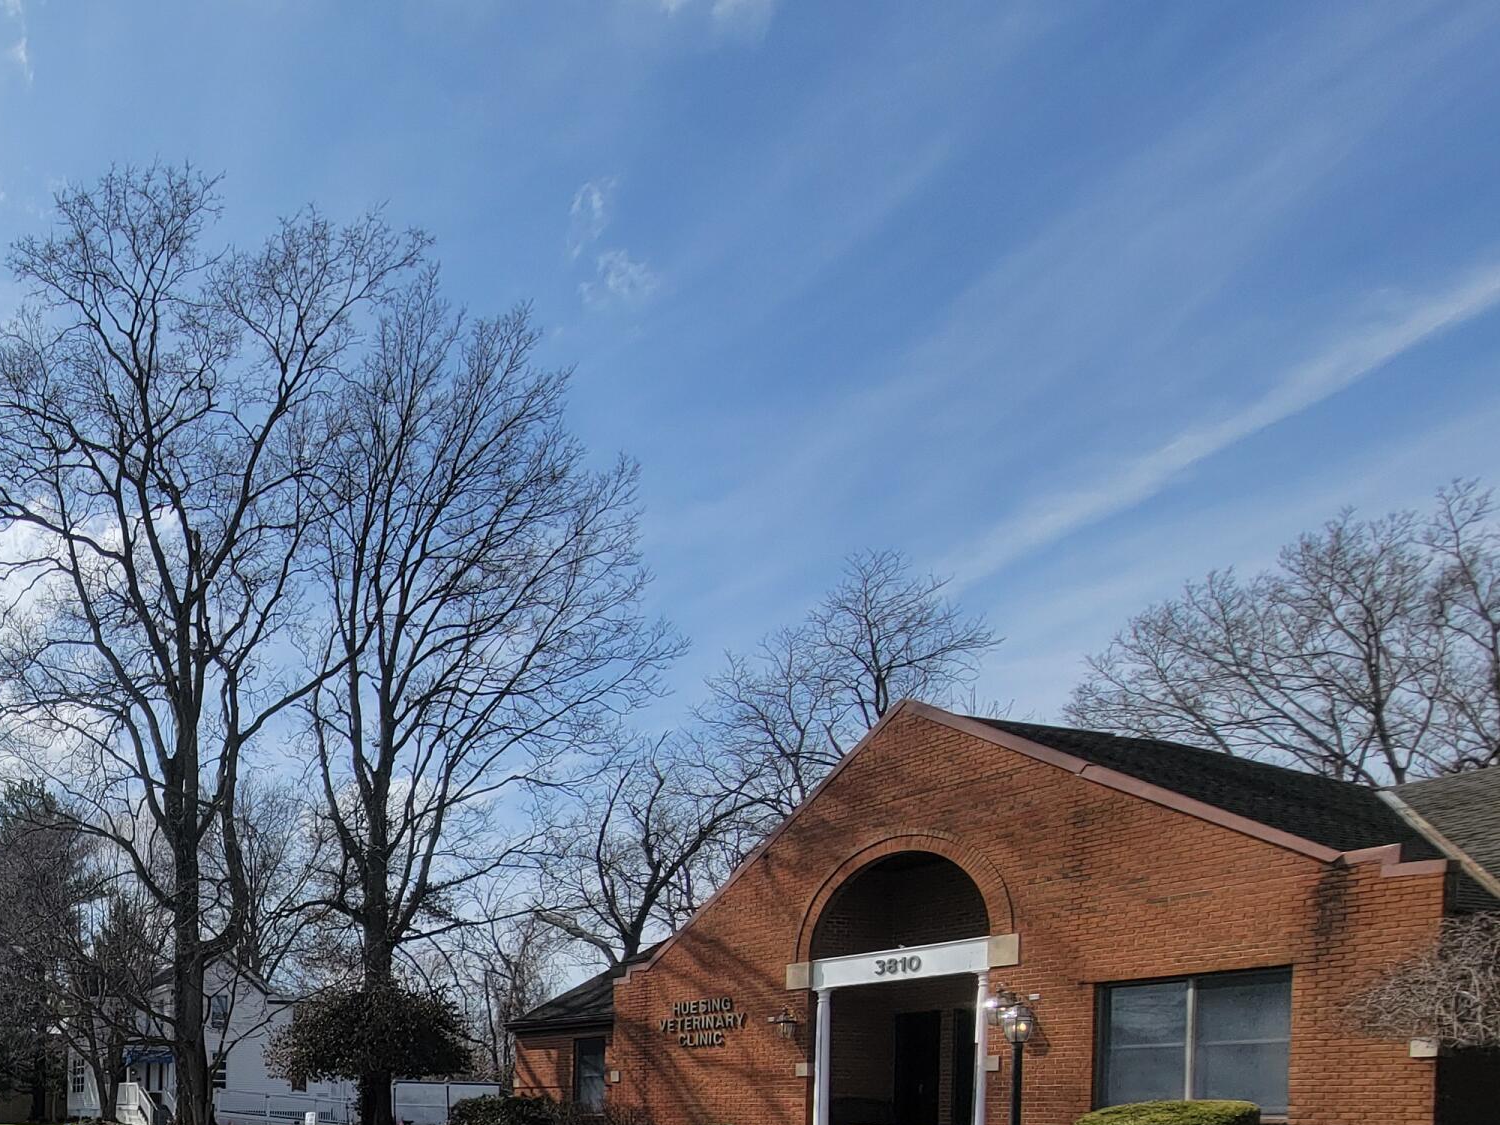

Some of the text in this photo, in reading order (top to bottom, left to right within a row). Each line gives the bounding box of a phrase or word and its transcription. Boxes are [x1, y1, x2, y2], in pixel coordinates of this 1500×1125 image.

[874, 956, 922, 976] 3810
[672, 997, 732, 1016] HUESING
[660, 1013, 746, 1033] VETERINARY
[678, 1031, 724, 1047] CLINIC
